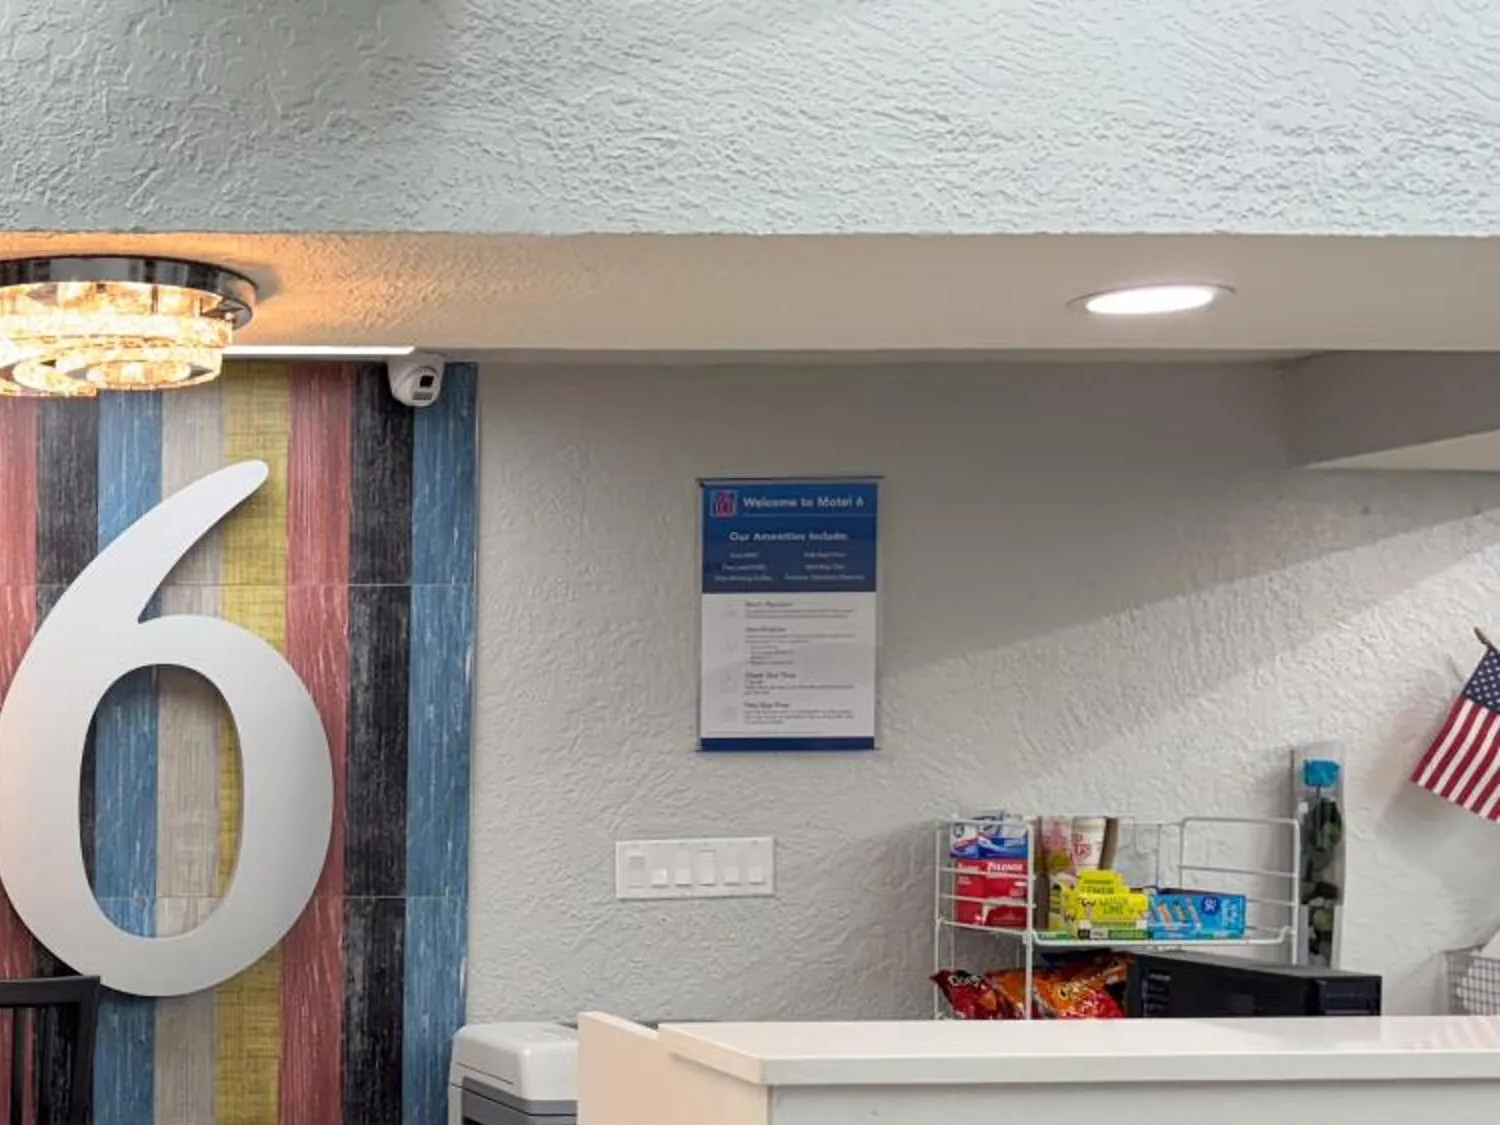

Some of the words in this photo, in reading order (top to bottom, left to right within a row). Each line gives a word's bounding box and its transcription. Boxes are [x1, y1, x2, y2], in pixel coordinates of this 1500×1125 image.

[743, 496, 798, 508] Welcome
[801, 497, 814, 508] to
[817, 495, 853, 508] Motel
[729, 531, 750, 541] Our
